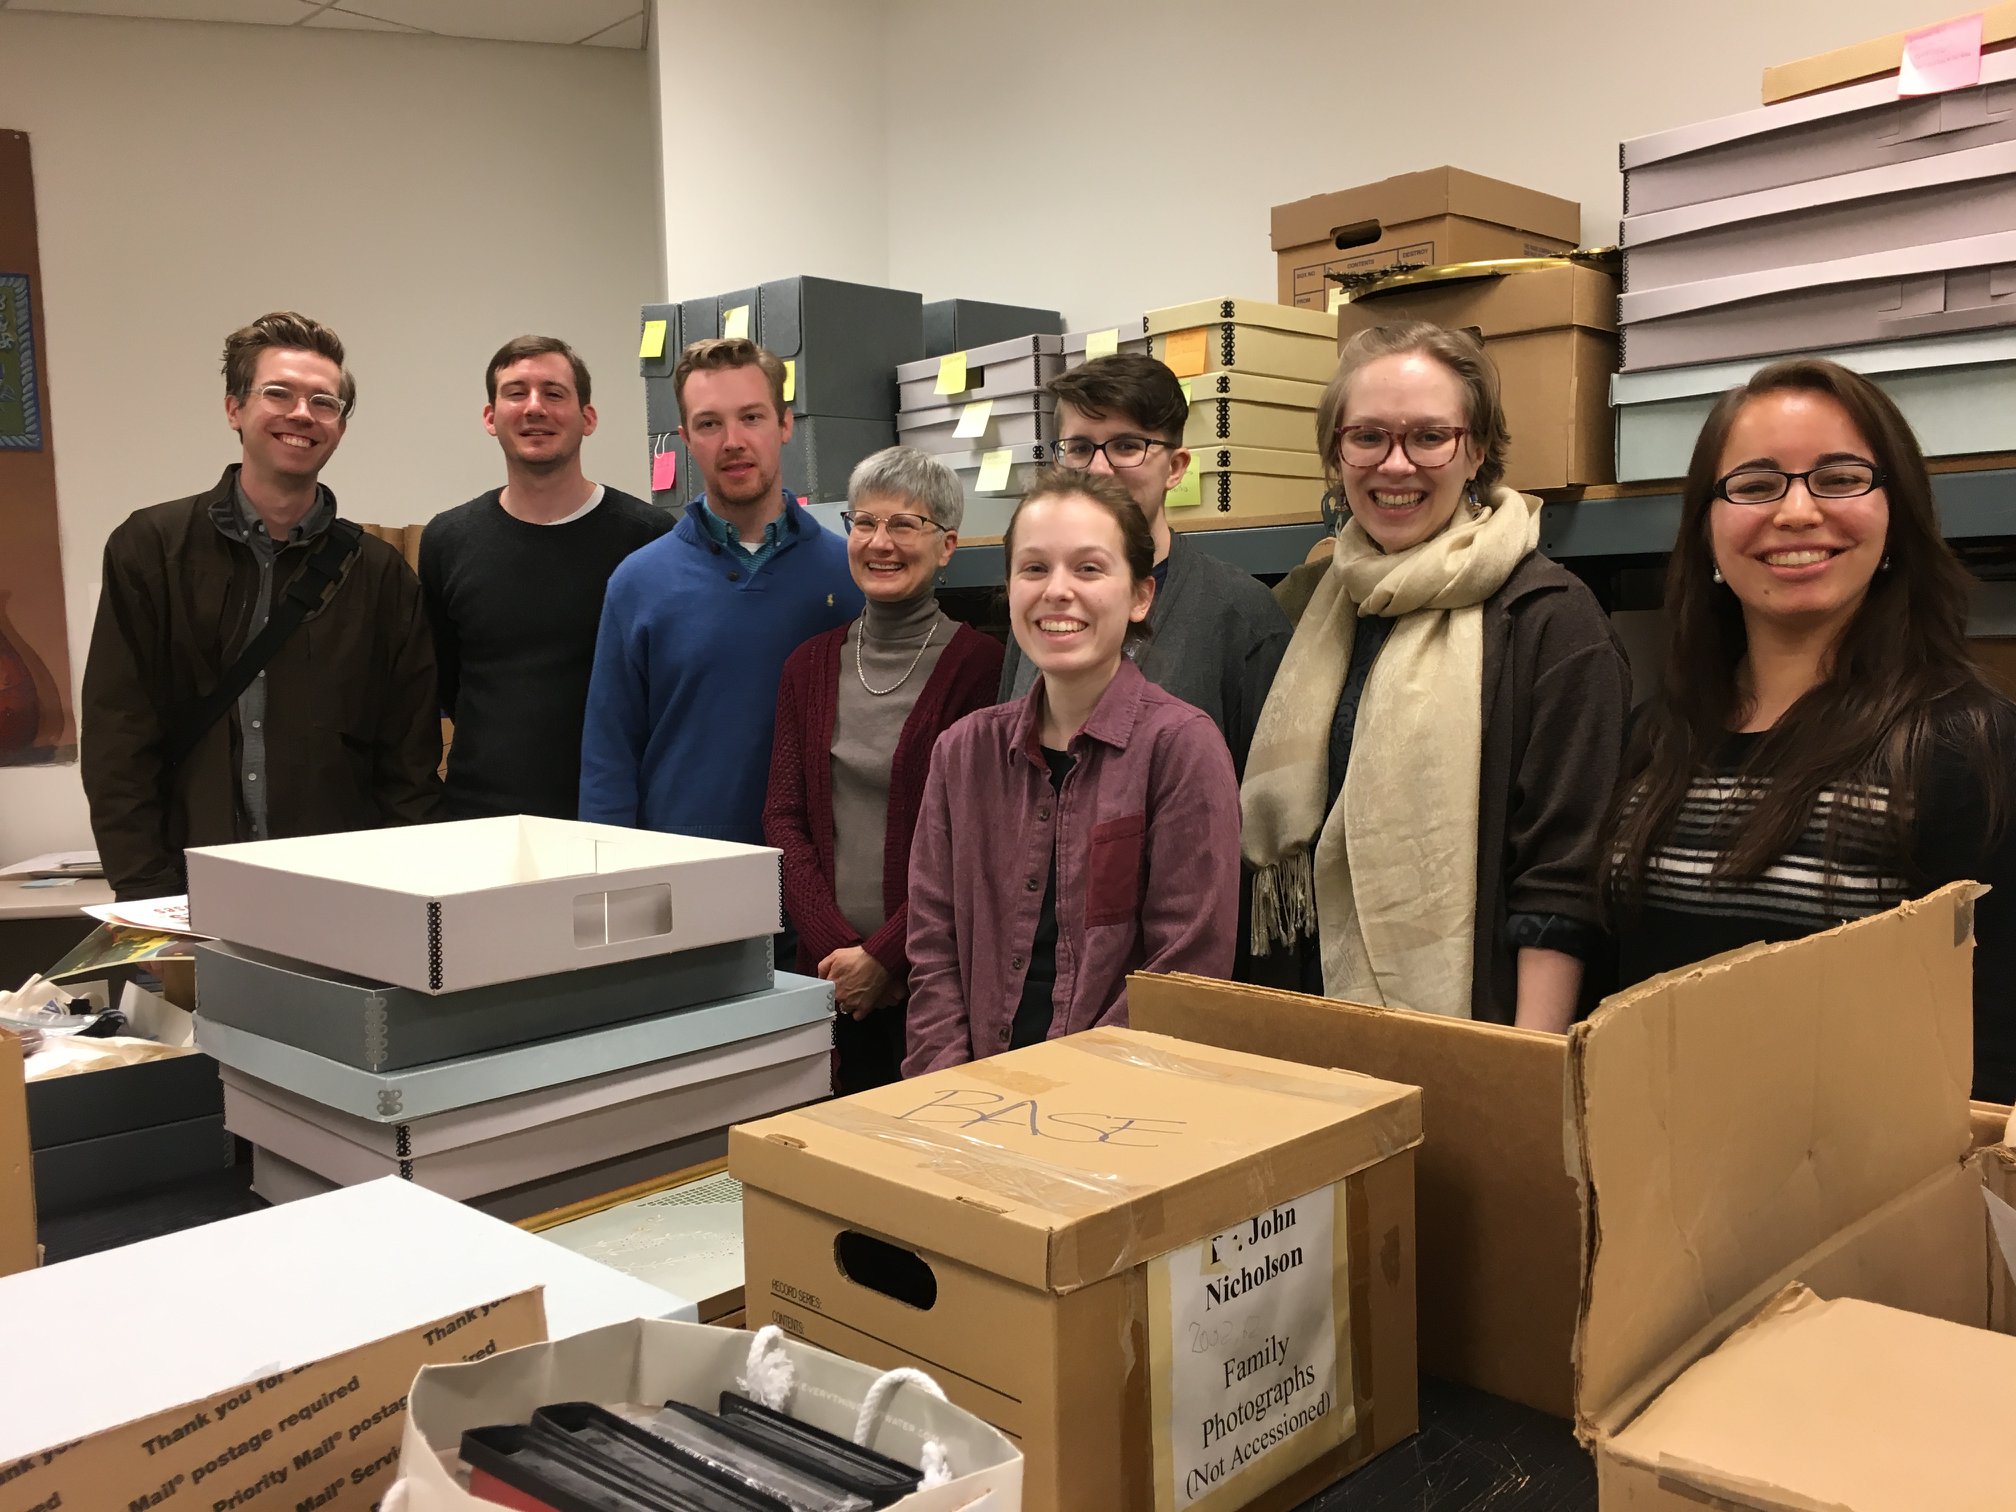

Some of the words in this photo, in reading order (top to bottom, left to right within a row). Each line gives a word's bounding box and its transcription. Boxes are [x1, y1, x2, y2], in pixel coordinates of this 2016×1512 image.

[1346, 258, 1375, 270] CONTENTS
[1402, 247, 1430, 259] DESTROY
[1296, 297, 1311, 305] FROM
[892, 1089, 1187, 1147] BASE
[1248, 1206, 1297, 1246] John
[771, 1278, 798, 1299] RECORD
[1205, 1246, 1304, 1312] Nicholson
[1222, 1334, 1290, 1390] Family
[141, 1412, 212, 1456] Thank
[214, 1389, 253, 1421] you
[191, 1427, 273, 1485] postage
[278, 1374, 361, 1433] required
[1201, 1363, 1315, 1450] Photographs
[1185, 1457, 1226, 1500] (Not
[1230, 1390, 1331, 1471] Accessioned)
[212, 1466, 289, 1512] Priority
